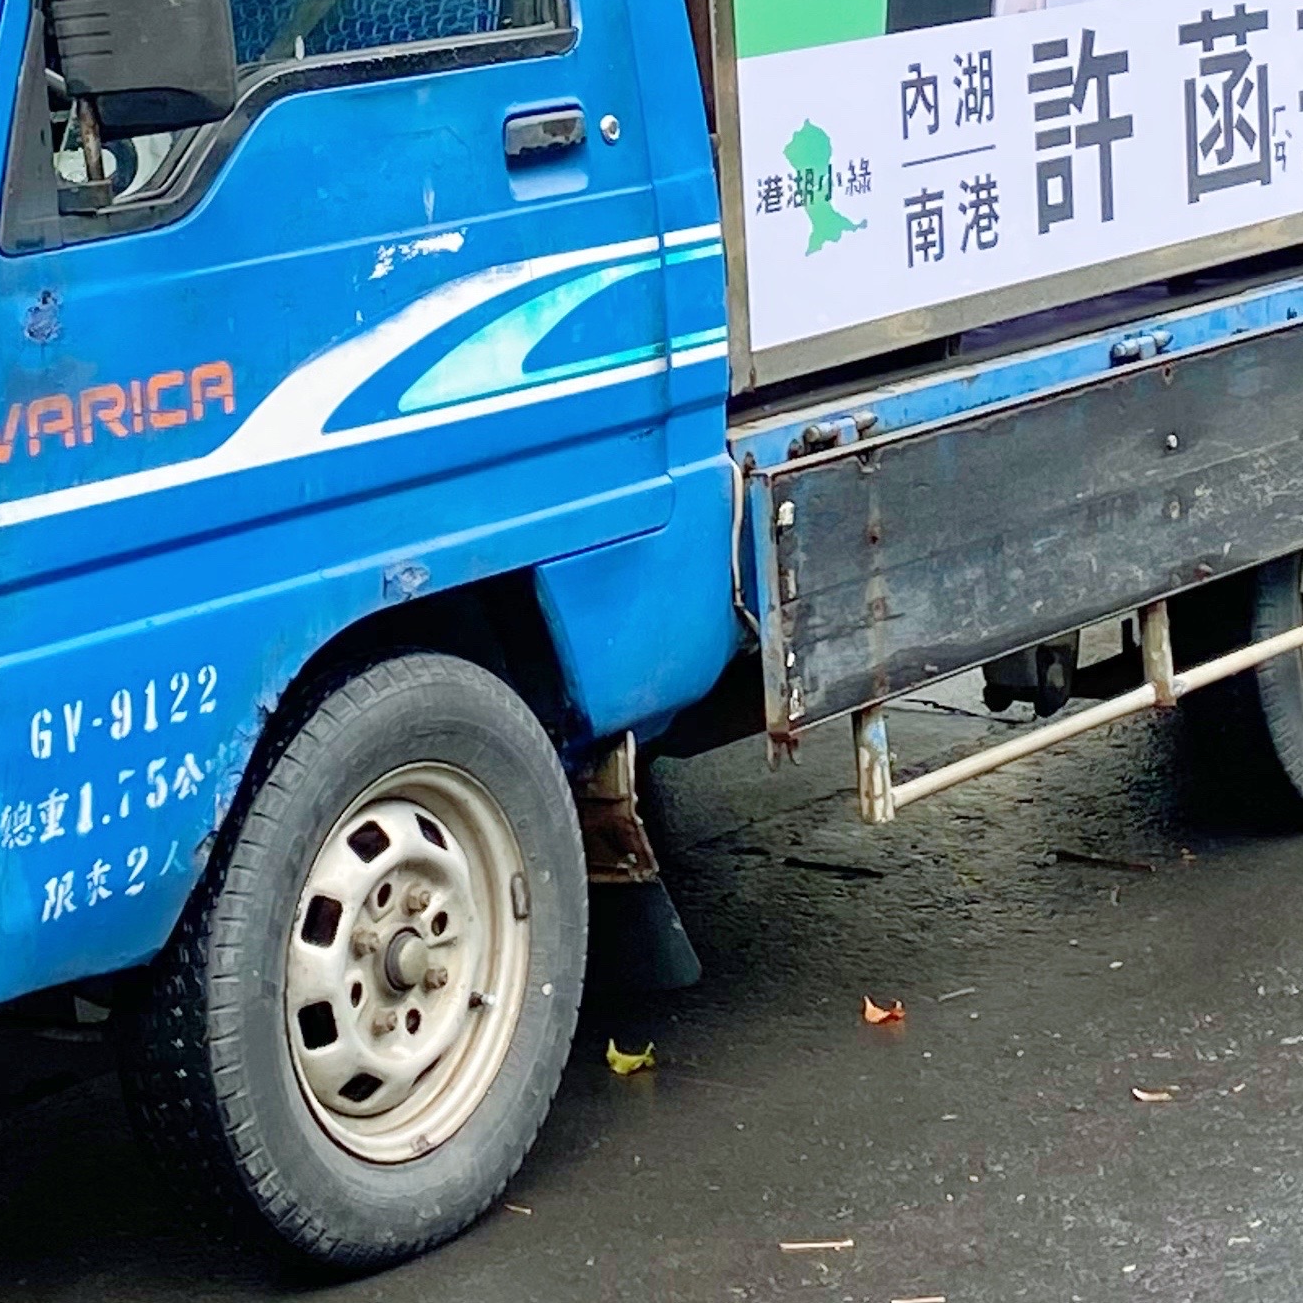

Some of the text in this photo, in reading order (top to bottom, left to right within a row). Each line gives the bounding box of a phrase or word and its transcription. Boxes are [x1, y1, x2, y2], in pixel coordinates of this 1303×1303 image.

[756, 158, 872, 215] 港湖小綠
[904, 173, 999, 268] 南港
[30, 664, 218, 759] GV-9122
